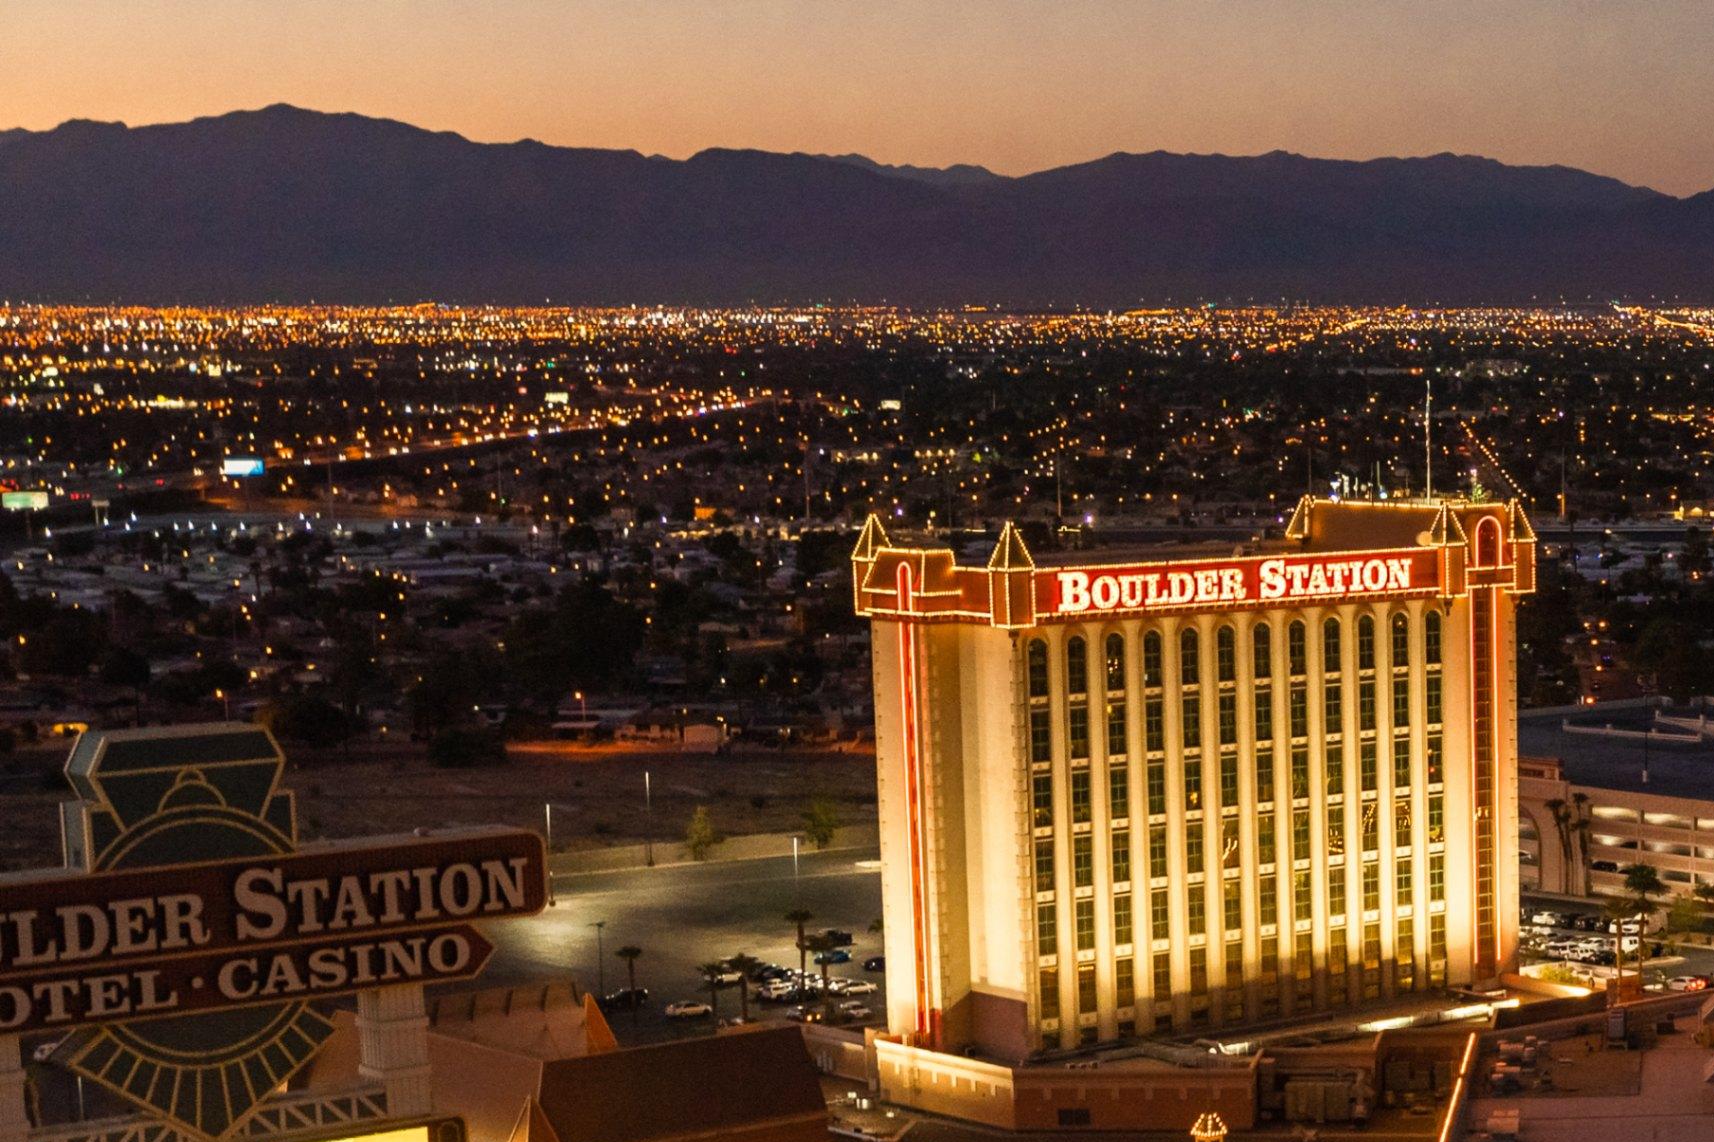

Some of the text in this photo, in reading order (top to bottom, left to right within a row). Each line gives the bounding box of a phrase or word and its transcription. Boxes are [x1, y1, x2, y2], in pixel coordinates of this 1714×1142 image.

[1057, 558, 1412, 613] BOULDER STATION
[0, 857, 528, 967] LDER STATION
[217, 933, 471, 1000] CASINO
